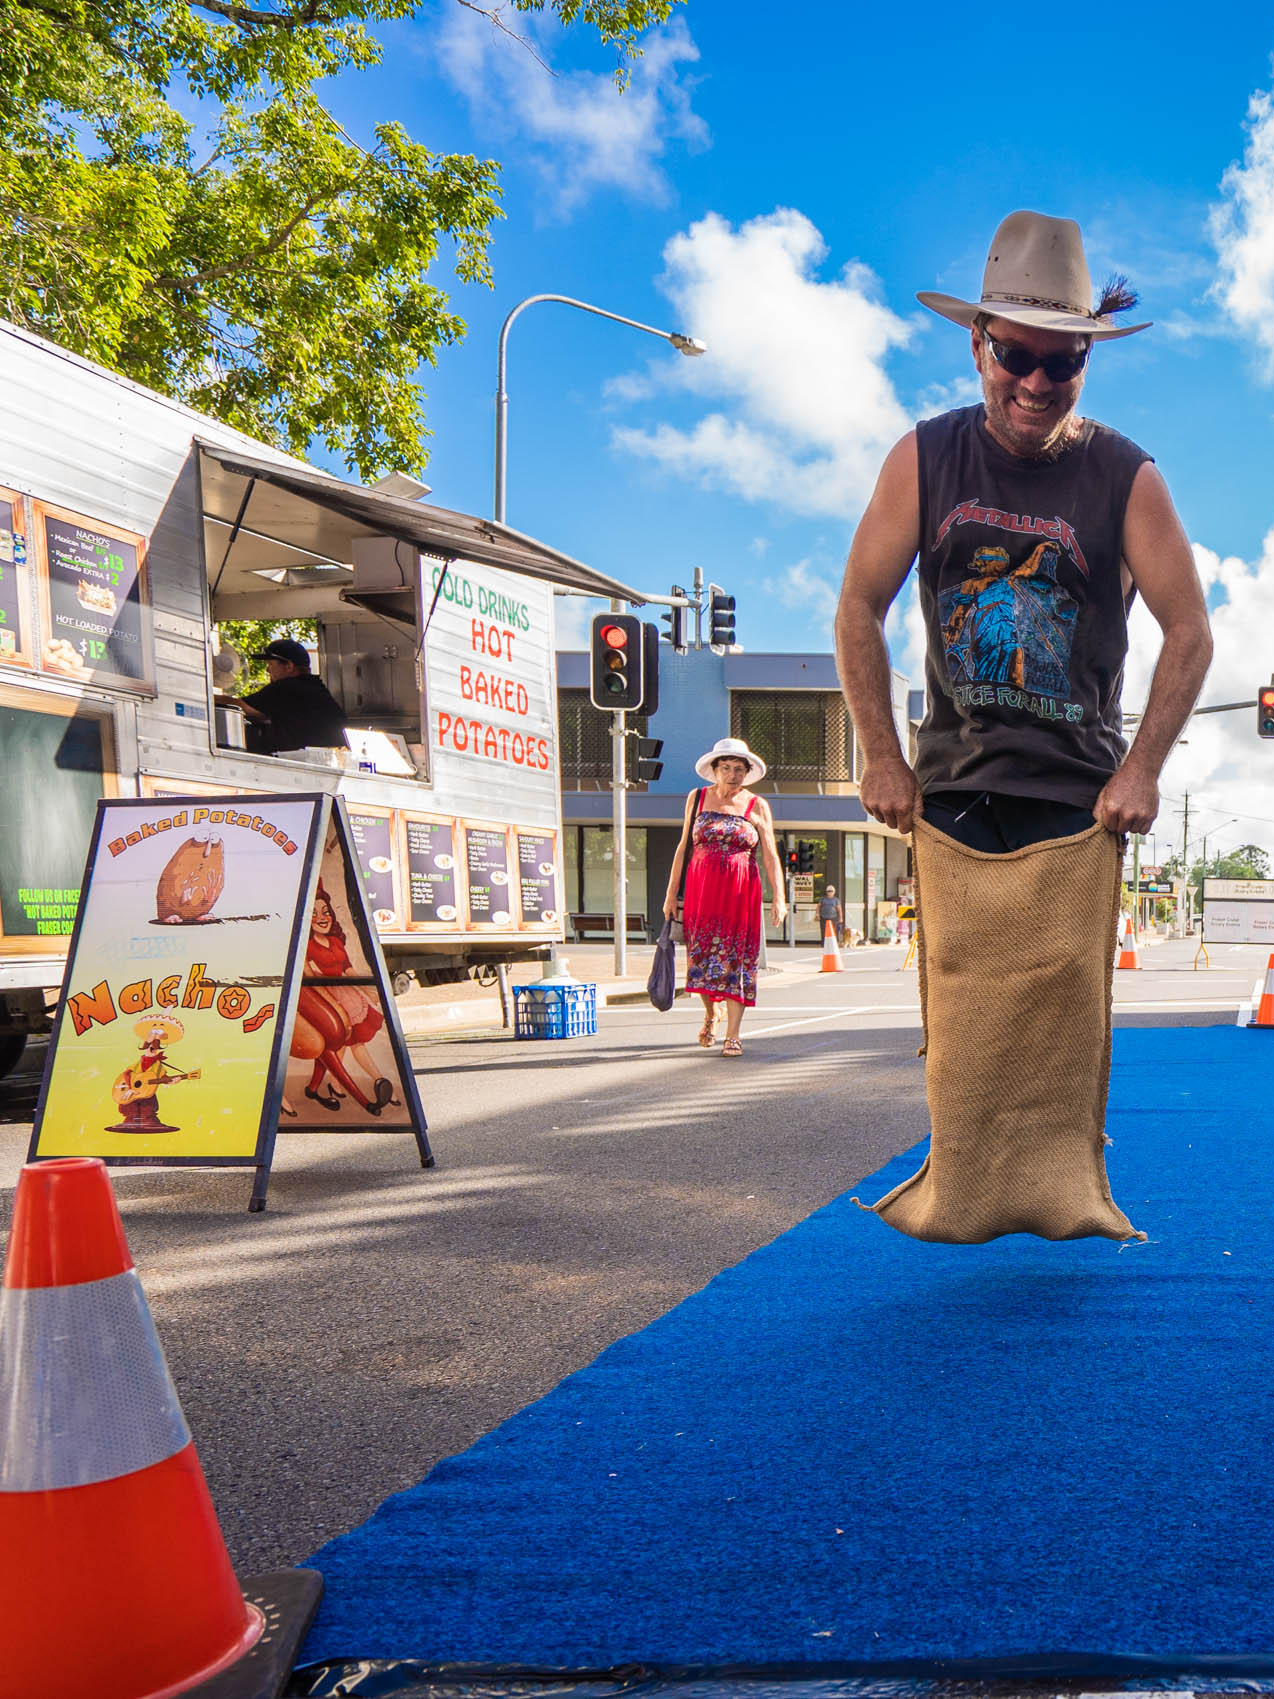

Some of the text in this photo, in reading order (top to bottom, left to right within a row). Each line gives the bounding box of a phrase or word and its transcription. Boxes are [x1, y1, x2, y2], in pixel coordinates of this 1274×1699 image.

[932, 498, 1089, 579] METALLICA
[83, 568, 104, 580] EXTRA
[432, 566, 530, 632] COLD DRINKS
[56, 614, 72, 626] HOT
[76, 618, 107, 634] LOADED
[471, 618, 515, 662] HOT
[460, 665, 529, 716] BAKED
[438, 711, 549, 770] POTATOES
[107, 811, 188, 858] Baked
[193, 808, 299, 856] Potatoes
[18, 888, 44, 903] FOLLOW
[44, 888, 53, 903] US
[54, 889, 62, 903] ON
[40, 905, 61, 919] BAKED
[37, 921, 61, 935] FRASER
[67, 963, 276, 1037] Nachos
